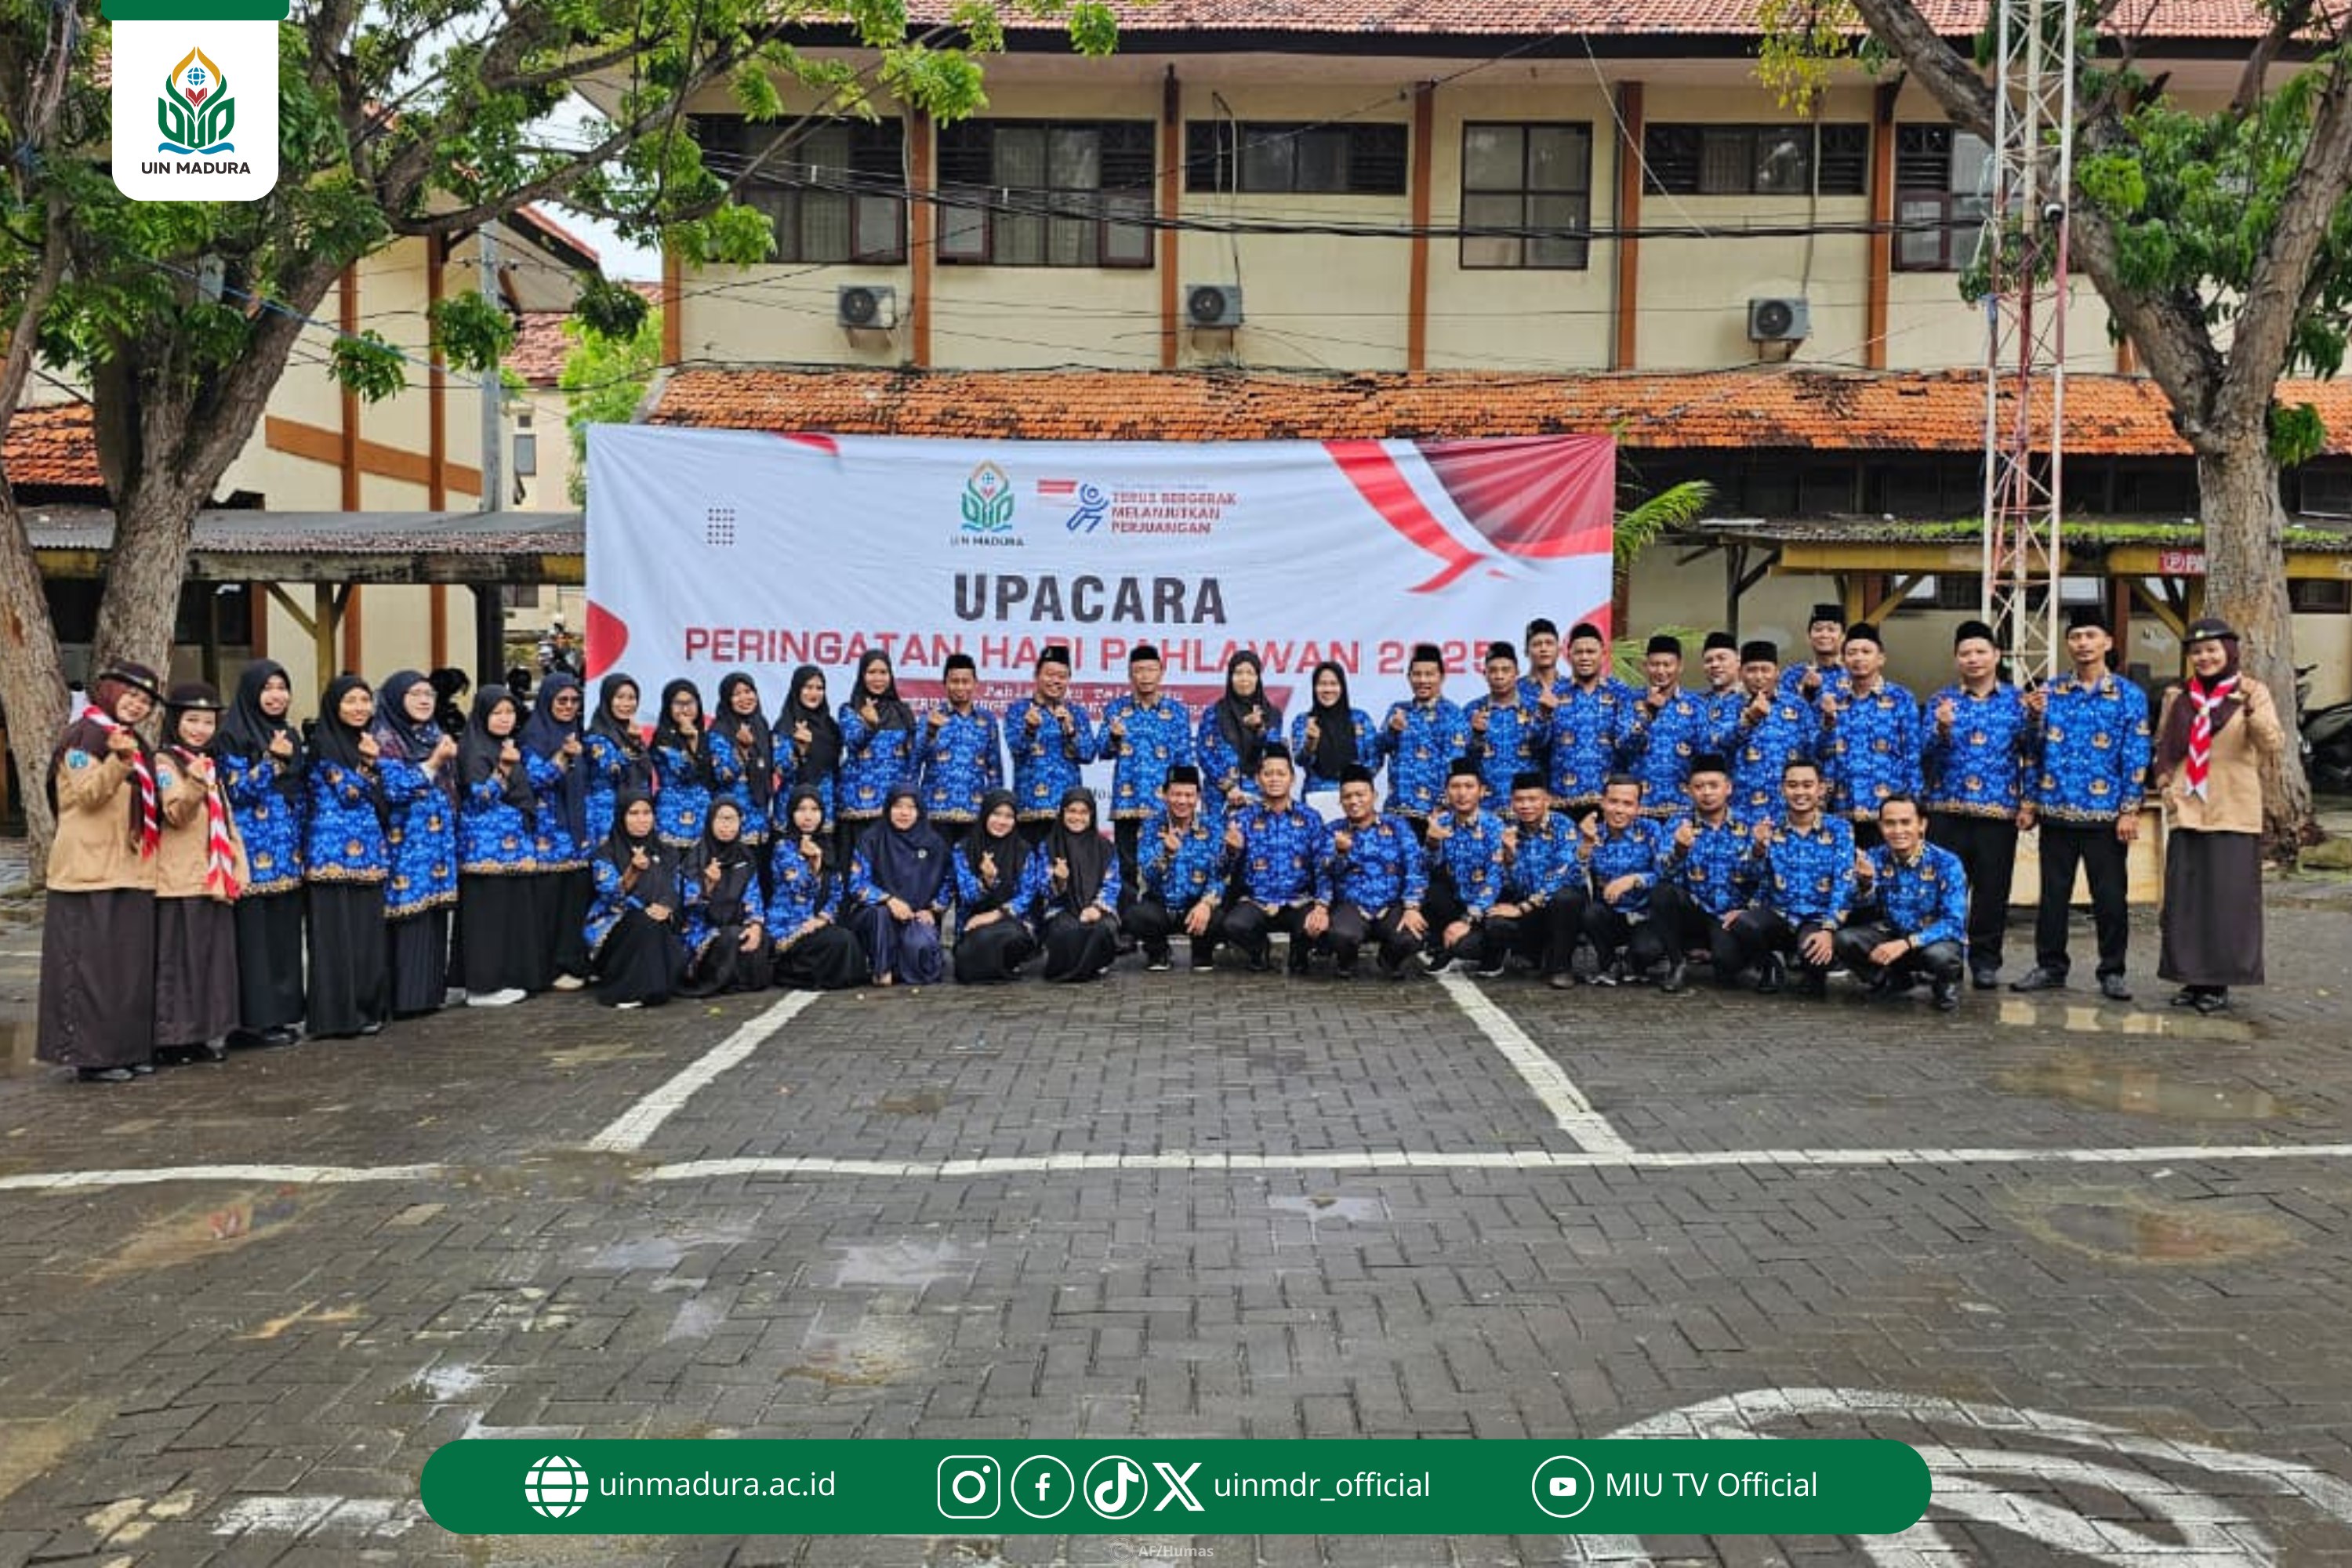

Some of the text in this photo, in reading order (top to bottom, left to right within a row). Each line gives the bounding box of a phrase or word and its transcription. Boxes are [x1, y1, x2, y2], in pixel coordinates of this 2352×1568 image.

[1111, 506, 1221, 521] MELANJUTKAN
[1111, 521, 1211, 534] PERJUANGAN
[953, 573, 1227, 625] UPACARA
[685, 627, 962, 668] PERINGATAN
[1099, 637, 1359, 675] PHLAWAN
